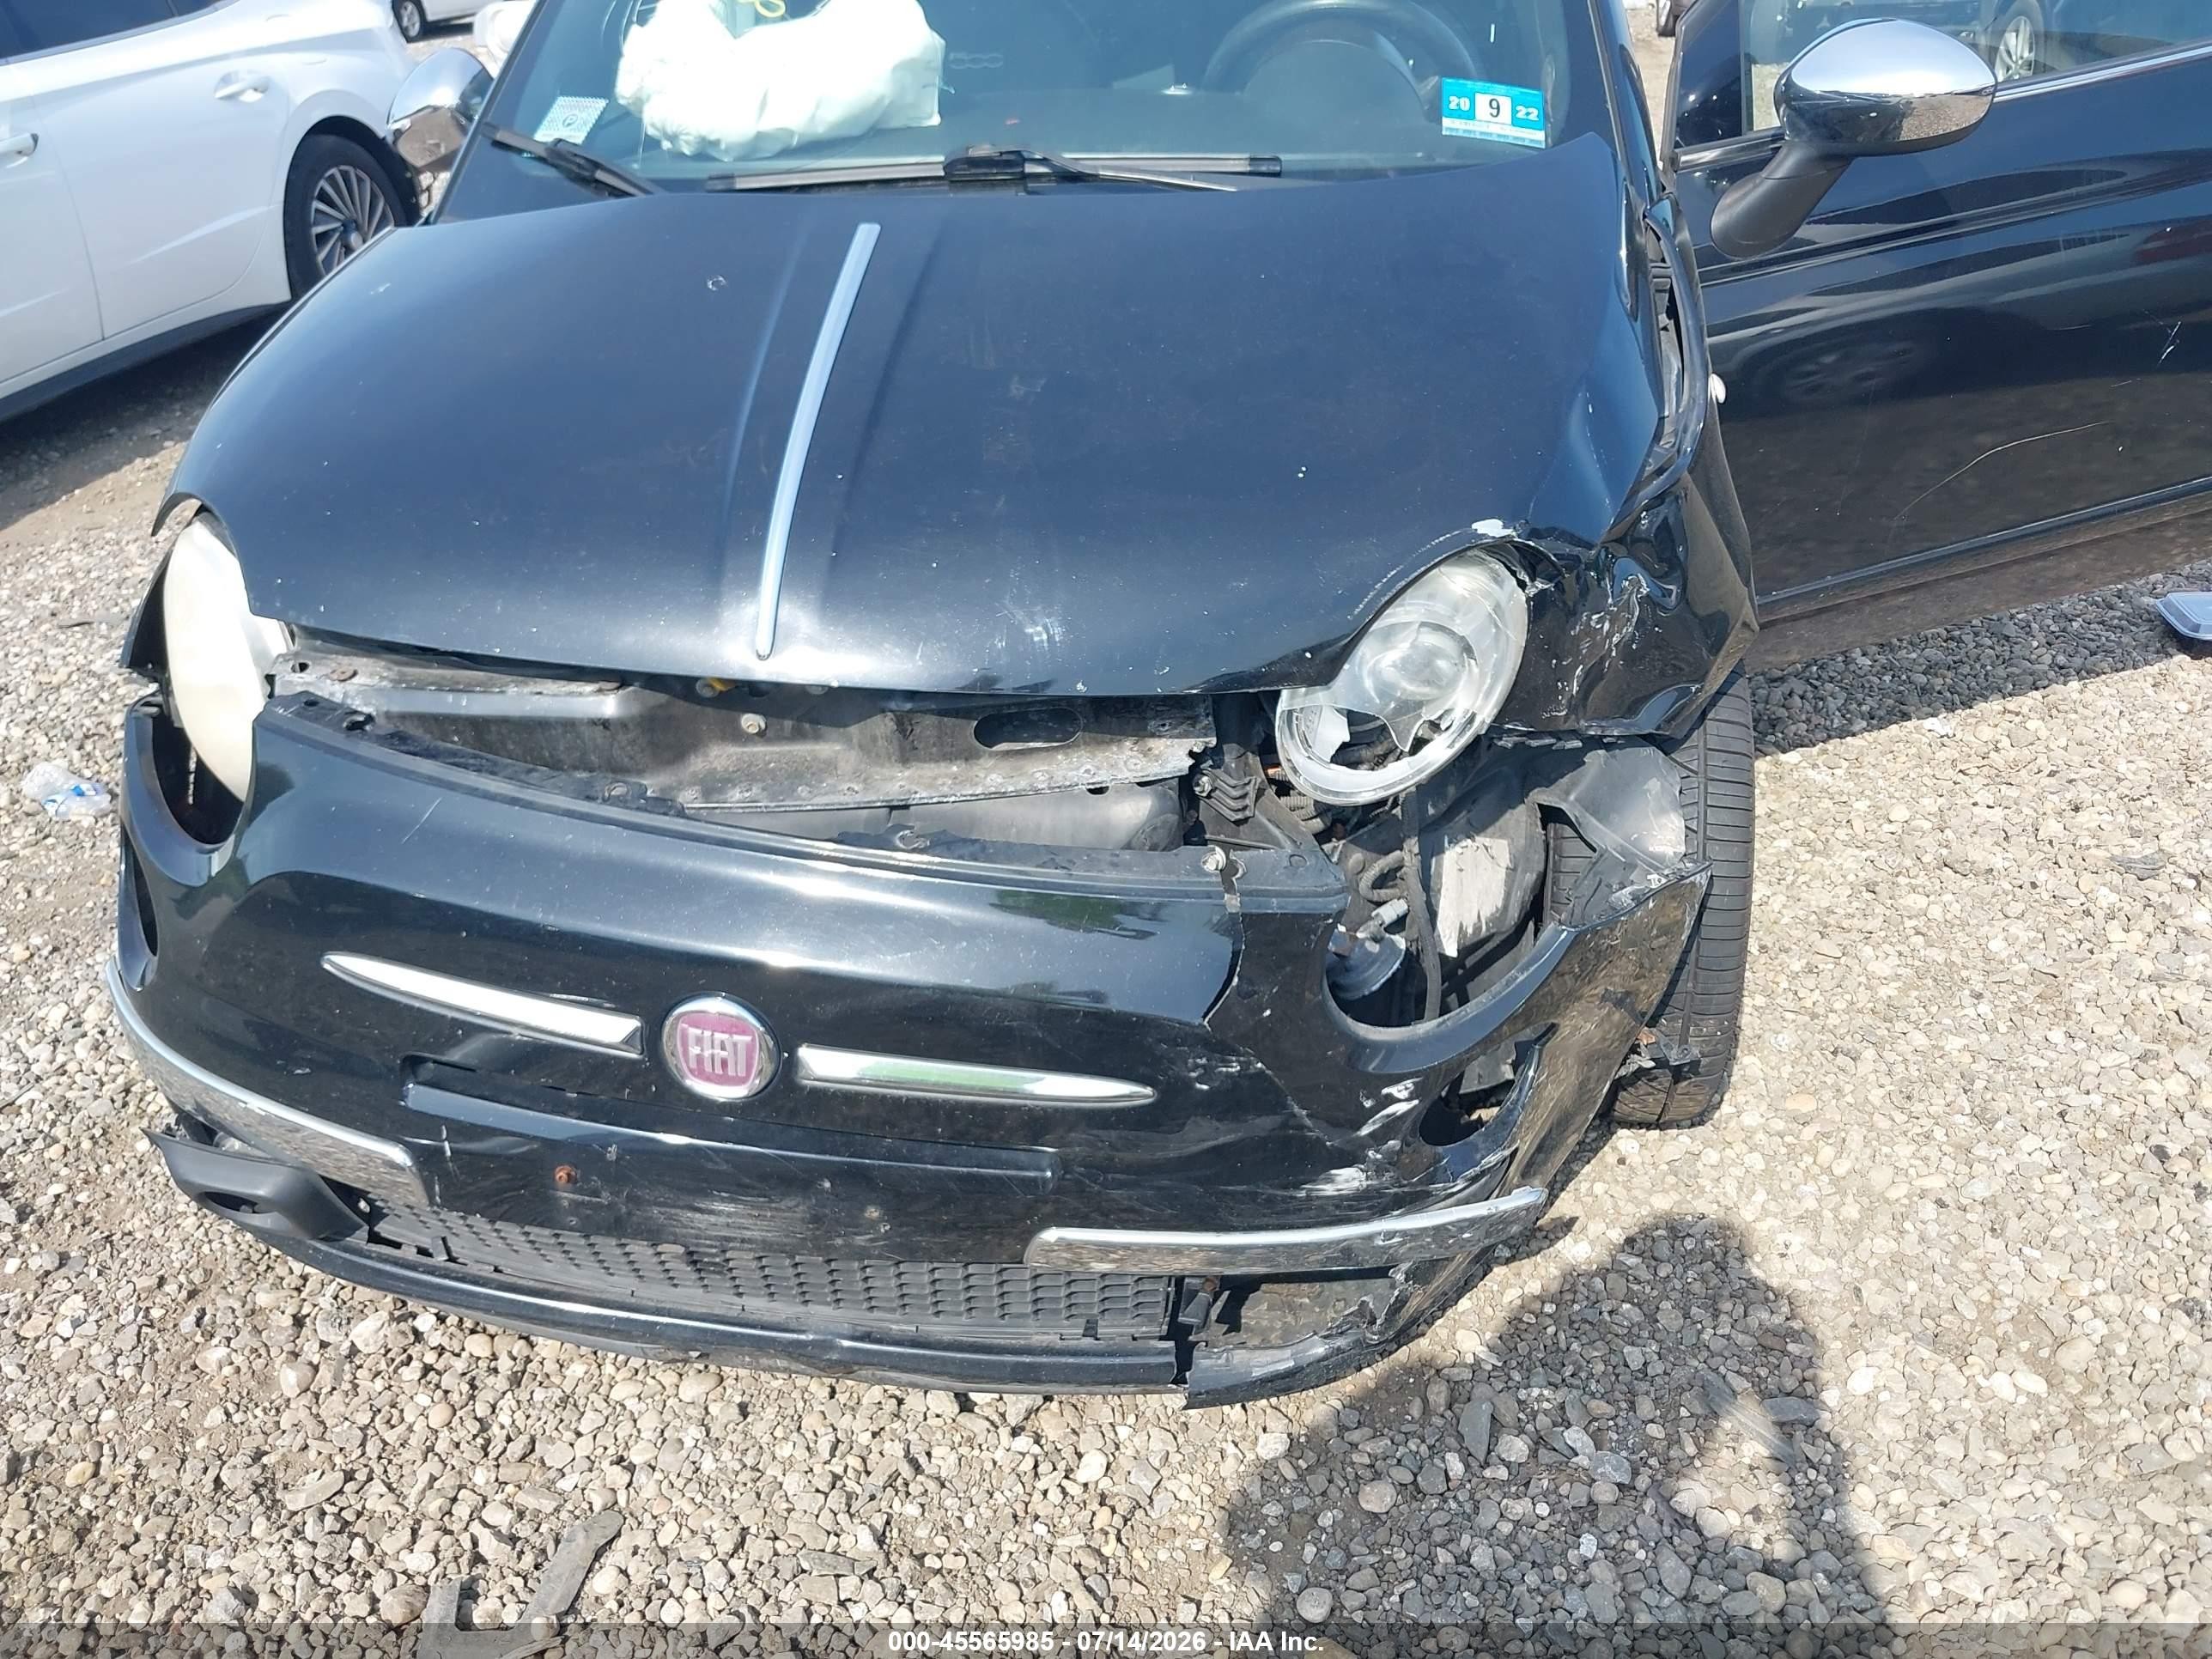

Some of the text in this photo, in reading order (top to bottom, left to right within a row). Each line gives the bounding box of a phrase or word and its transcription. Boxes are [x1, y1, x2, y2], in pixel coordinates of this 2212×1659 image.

[1449, 95, 1539, 121] 20 9 22
[680, 1023, 753, 1077] FIAT
